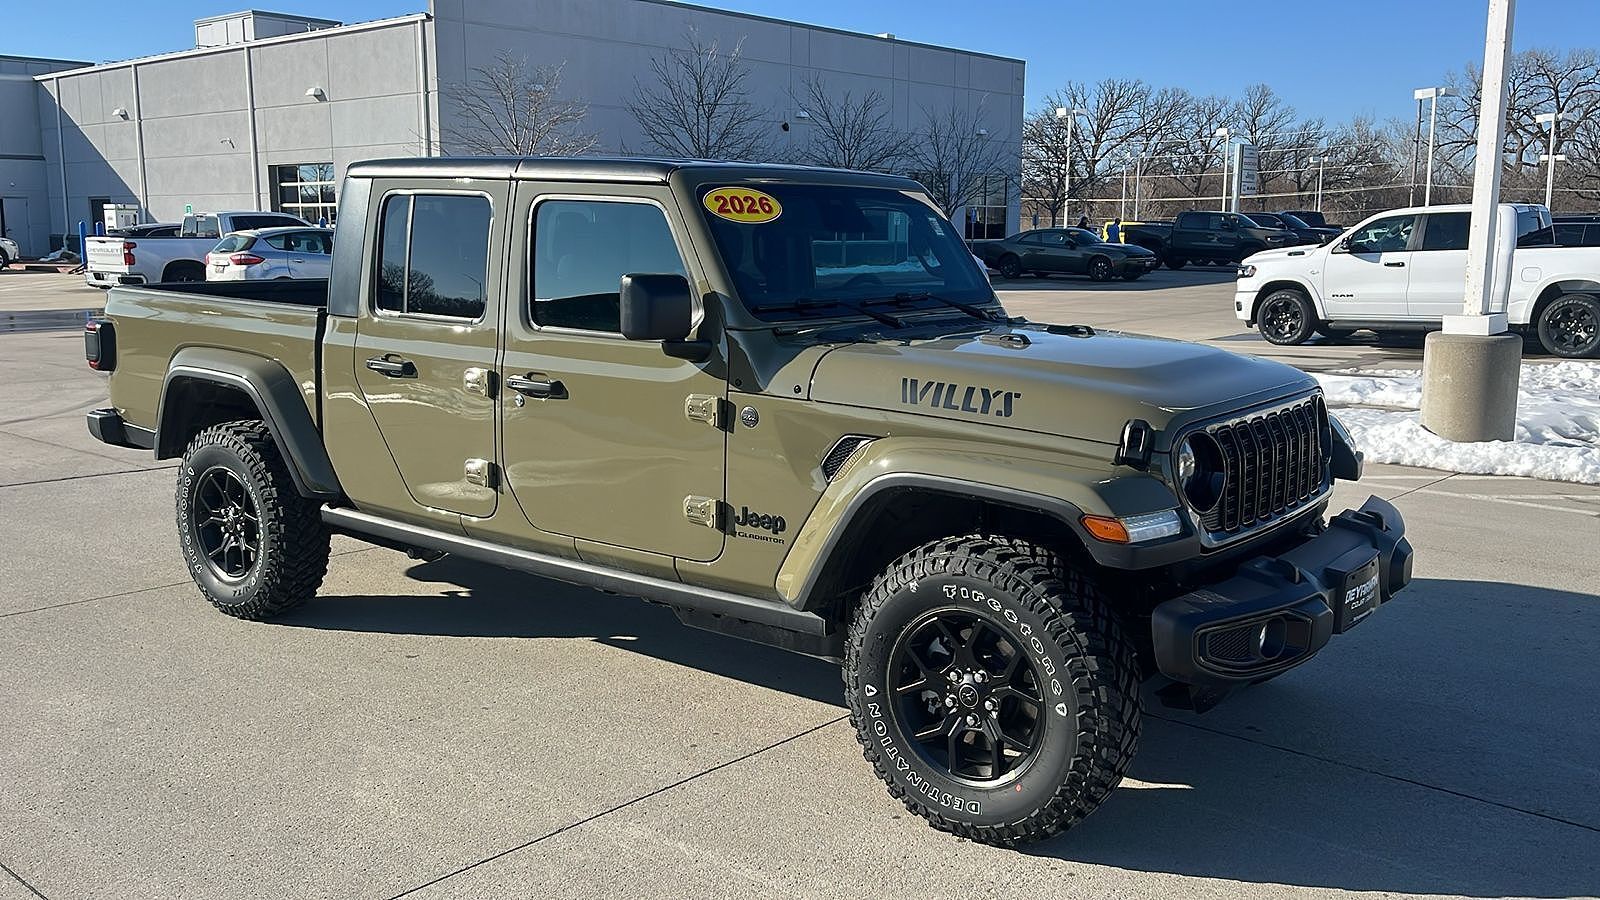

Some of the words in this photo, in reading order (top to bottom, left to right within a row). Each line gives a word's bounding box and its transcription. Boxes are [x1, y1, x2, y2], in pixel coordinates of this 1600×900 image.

[714, 195, 773, 214] 2026
[902, 377, 1022, 418] WILLYS
[735, 506, 787, 535] Jeep
[737, 531, 786, 544] GLADIATOR
[943, 585, 1063, 696] Firestone
[868, 702, 983, 816] DESTINATION
